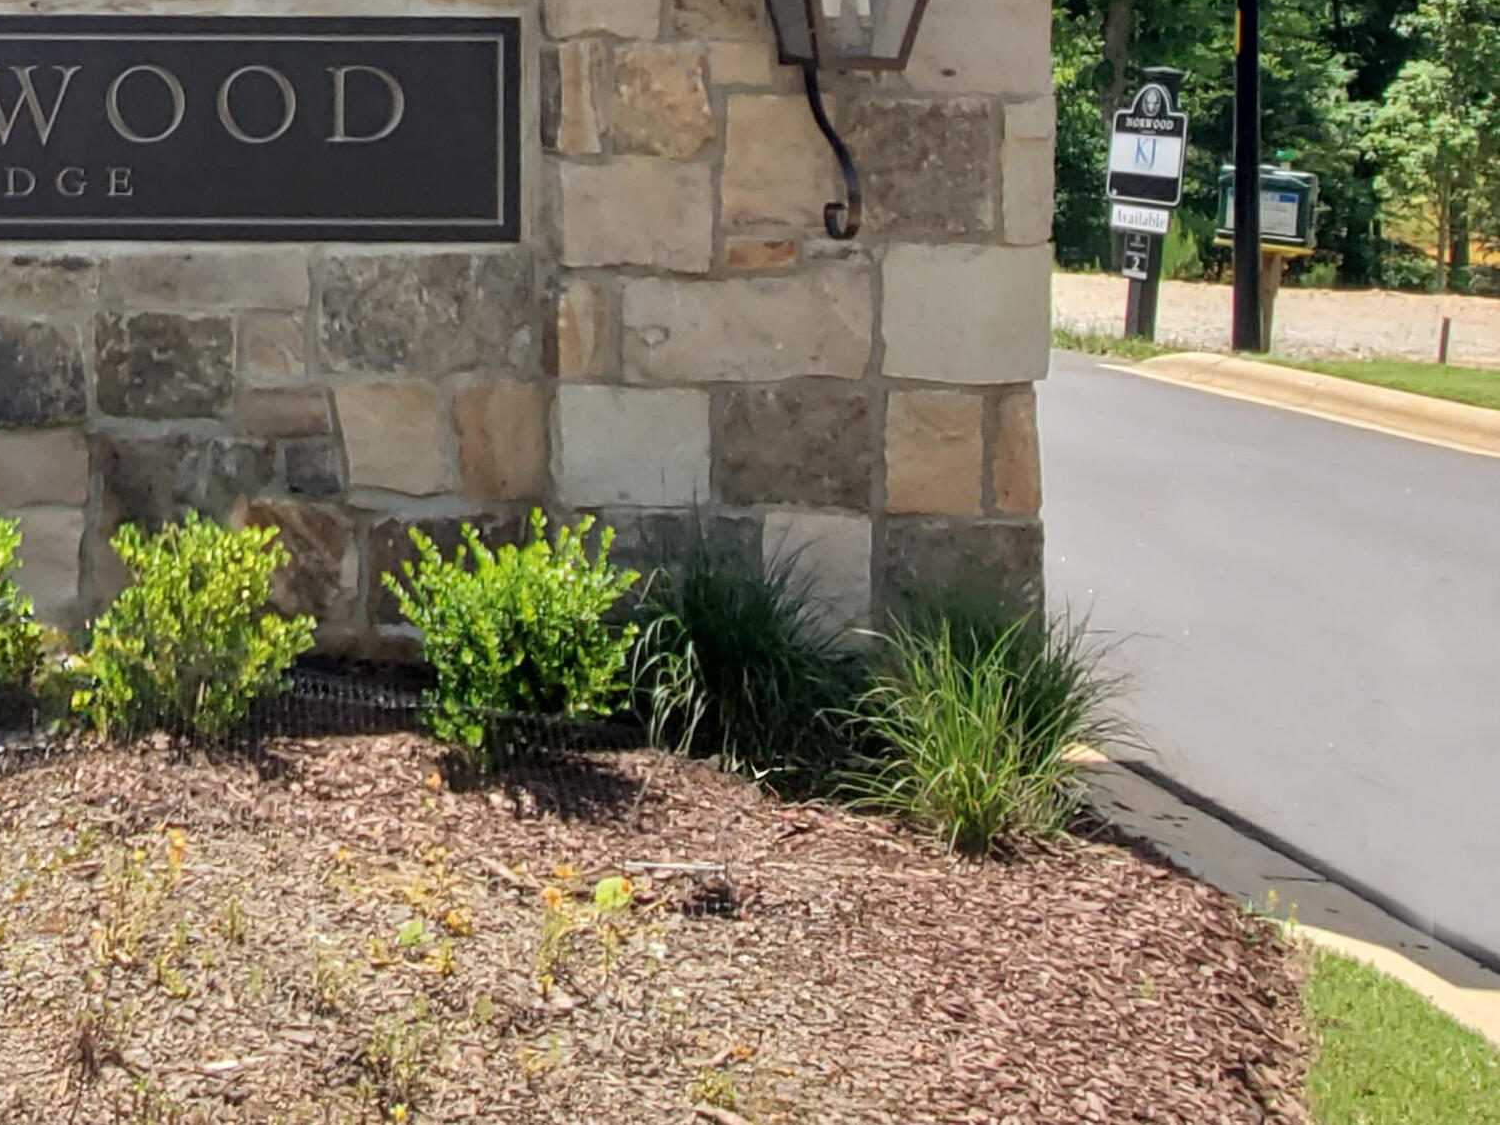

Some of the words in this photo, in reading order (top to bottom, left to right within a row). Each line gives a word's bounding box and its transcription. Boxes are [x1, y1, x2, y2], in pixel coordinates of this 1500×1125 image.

[1125, 117, 1174, 130] NORWOOD
[1116, 209, 1165, 229] Available
[1132, 257, 1140, 270] 2
